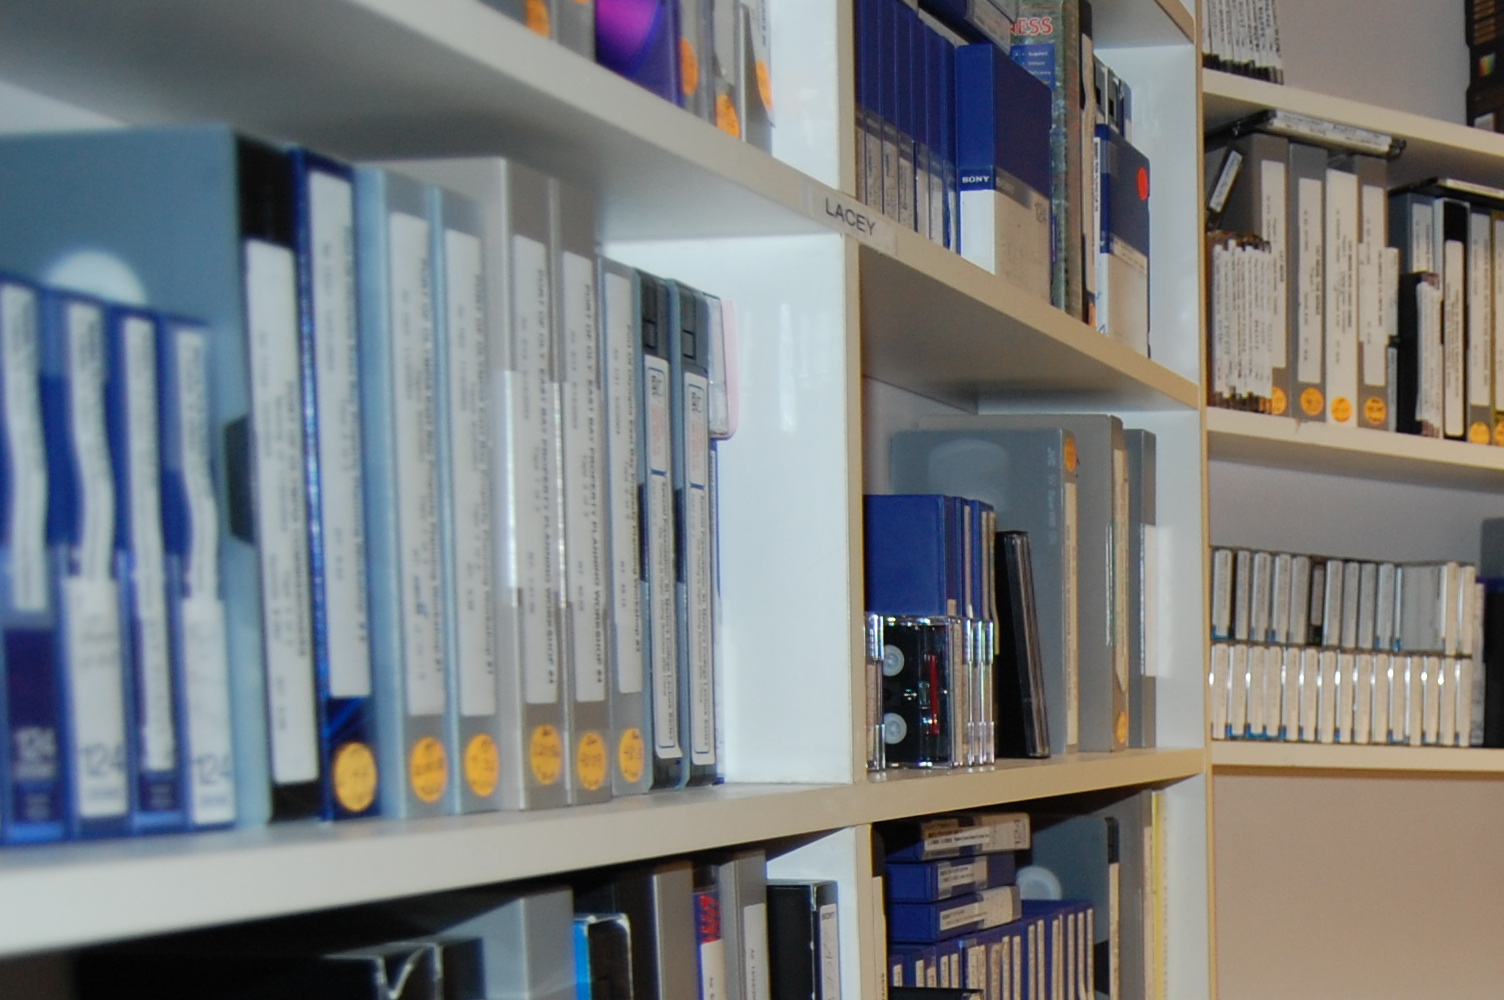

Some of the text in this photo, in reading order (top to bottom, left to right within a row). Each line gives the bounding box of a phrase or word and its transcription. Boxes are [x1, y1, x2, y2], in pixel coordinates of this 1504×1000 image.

[962, 176, 990, 184] SONY
[825, 197, 876, 236] LACEY
[537, 270, 545, 306] PORT
[541, 439, 551, 510] PROPERTY
[588, 447, 599, 516] PROPERTY
[544, 516, 552, 583] PLANNING
[591, 522, 600, 586] PLANNING
[545, 588, 555, 664] WORKSHOP
[594, 590, 603, 665] WORKSHOP
[633, 578, 641, 635] Workshop
